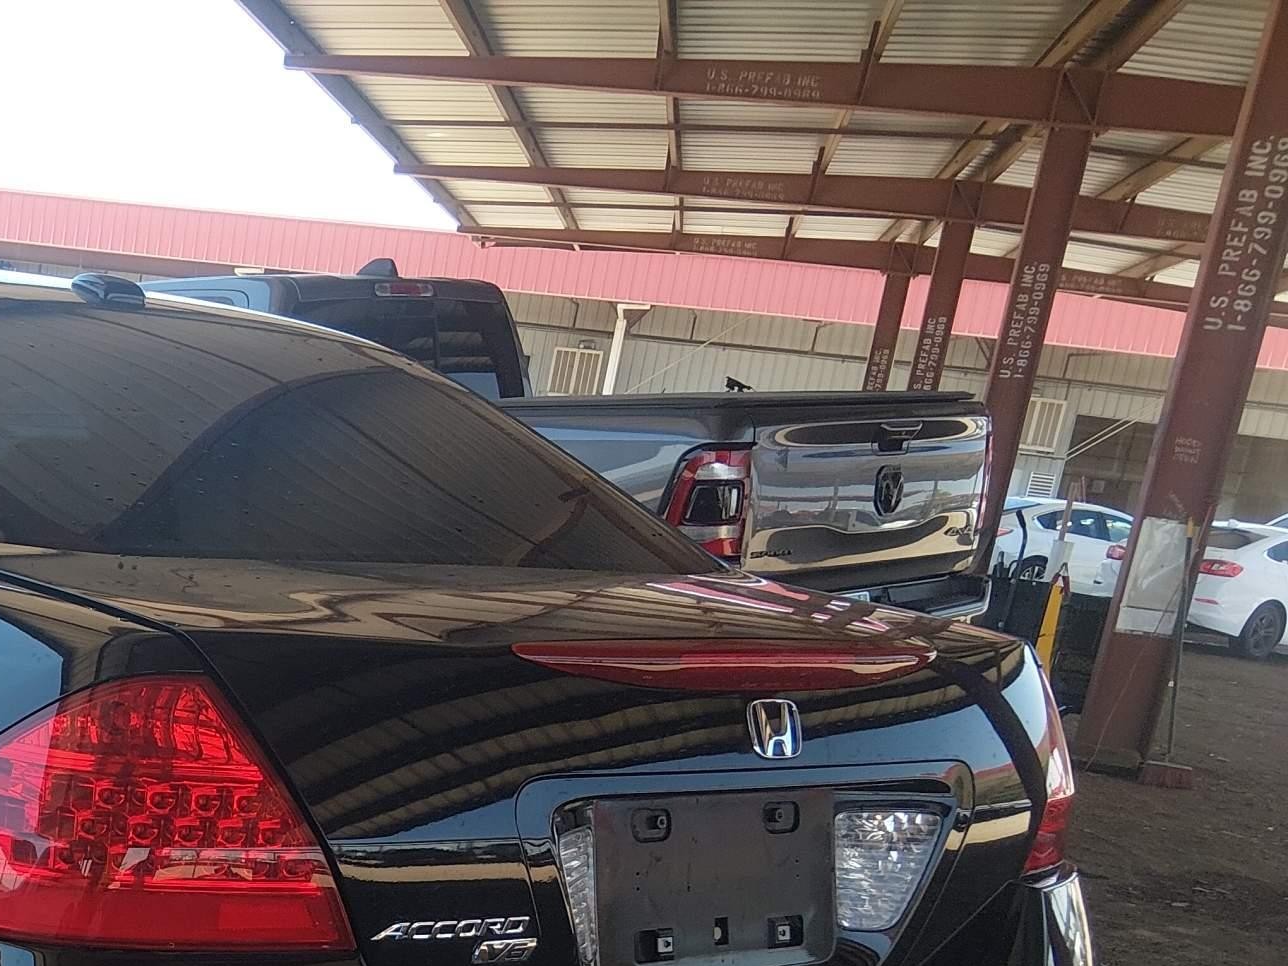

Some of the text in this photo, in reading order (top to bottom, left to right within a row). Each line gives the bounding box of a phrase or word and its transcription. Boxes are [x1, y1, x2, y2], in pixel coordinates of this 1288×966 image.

[1203, 135, 1275, 331] U.S. PREFAB INC.
[1226, 136, 1288, 331] 1-866-799-0969
[916, 338, 932, 376] PREFAB
[999, 261, 1038, 379] U.S. PREFAB INC.
[1013, 263, 1051, 379] 1-866-799-0969
[370, 916, 530, 940] ACCORD
[472, 938, 538, 965] V6
